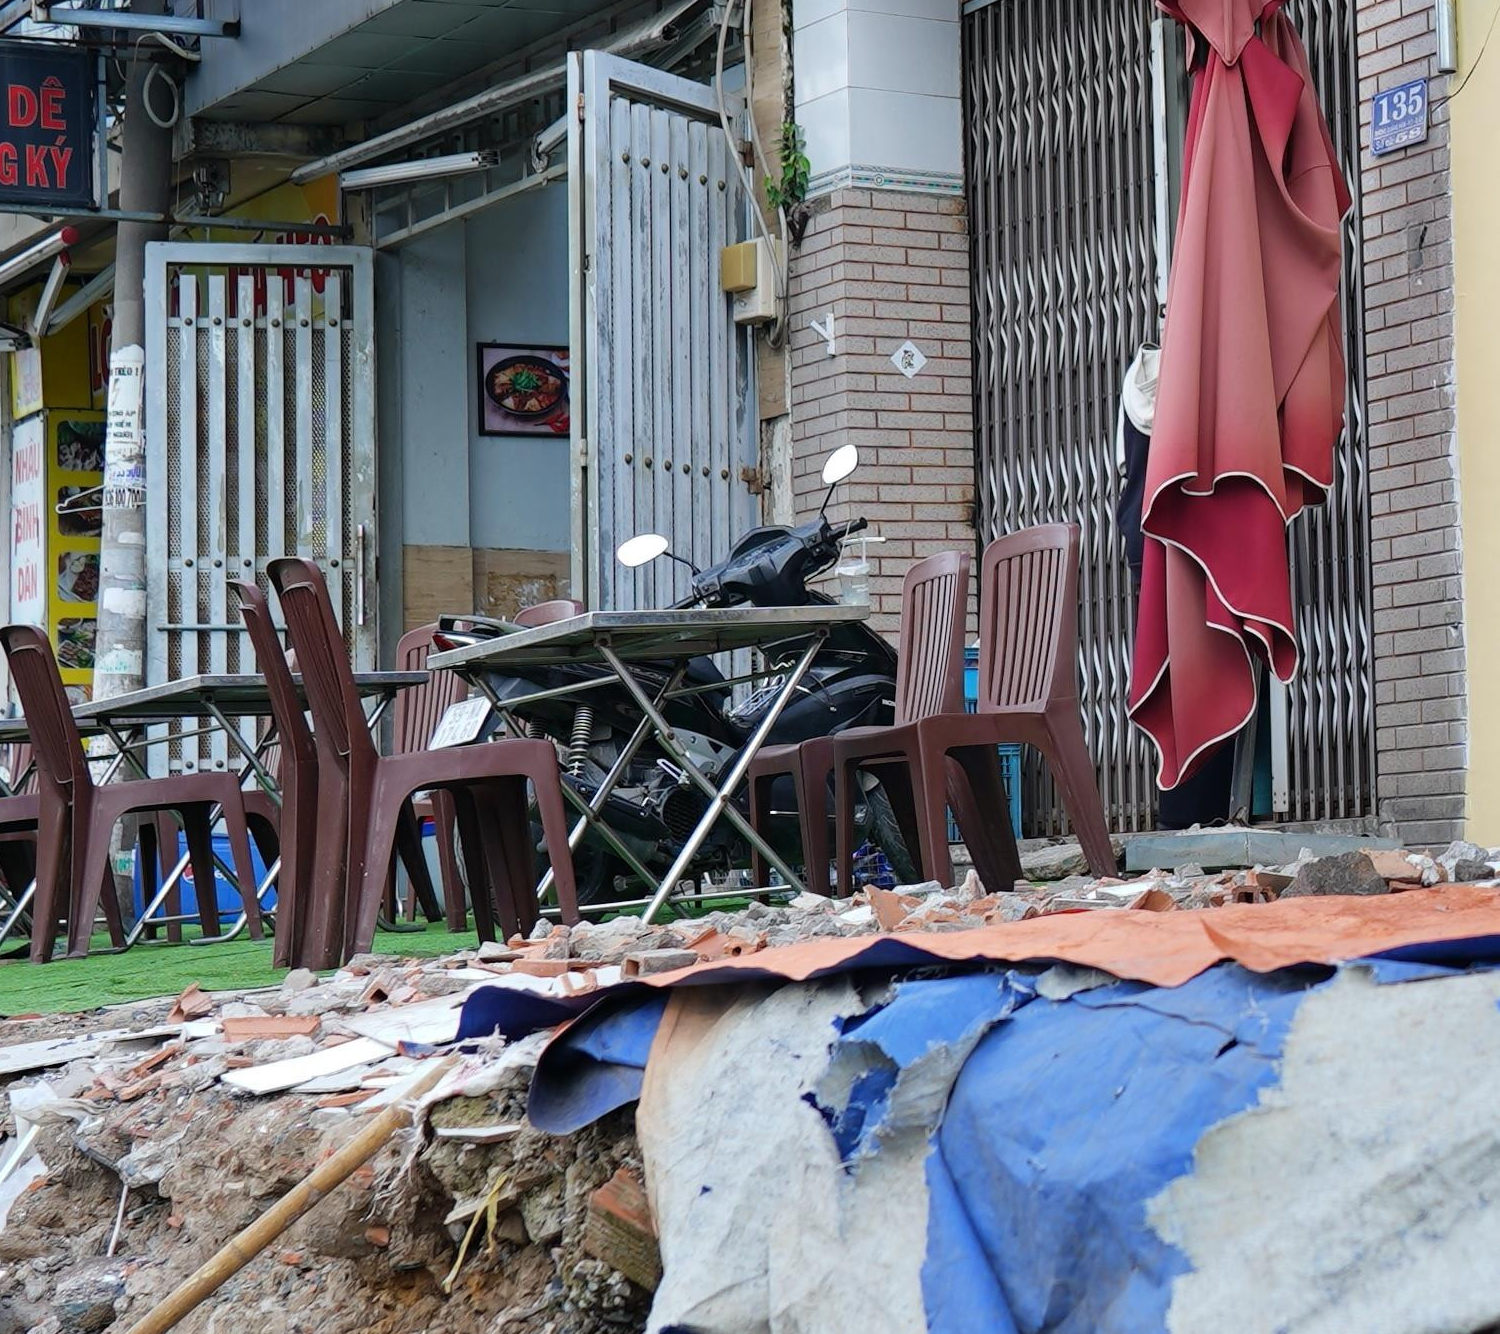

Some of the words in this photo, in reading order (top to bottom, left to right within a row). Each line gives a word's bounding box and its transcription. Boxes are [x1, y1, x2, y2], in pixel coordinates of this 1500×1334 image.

[8, 76, 67, 130] DÊ
[1378, 84, 1424, 126] 135
[25, 135, 73, 189] KÝ
[17, 556, 38, 602] DÂN
